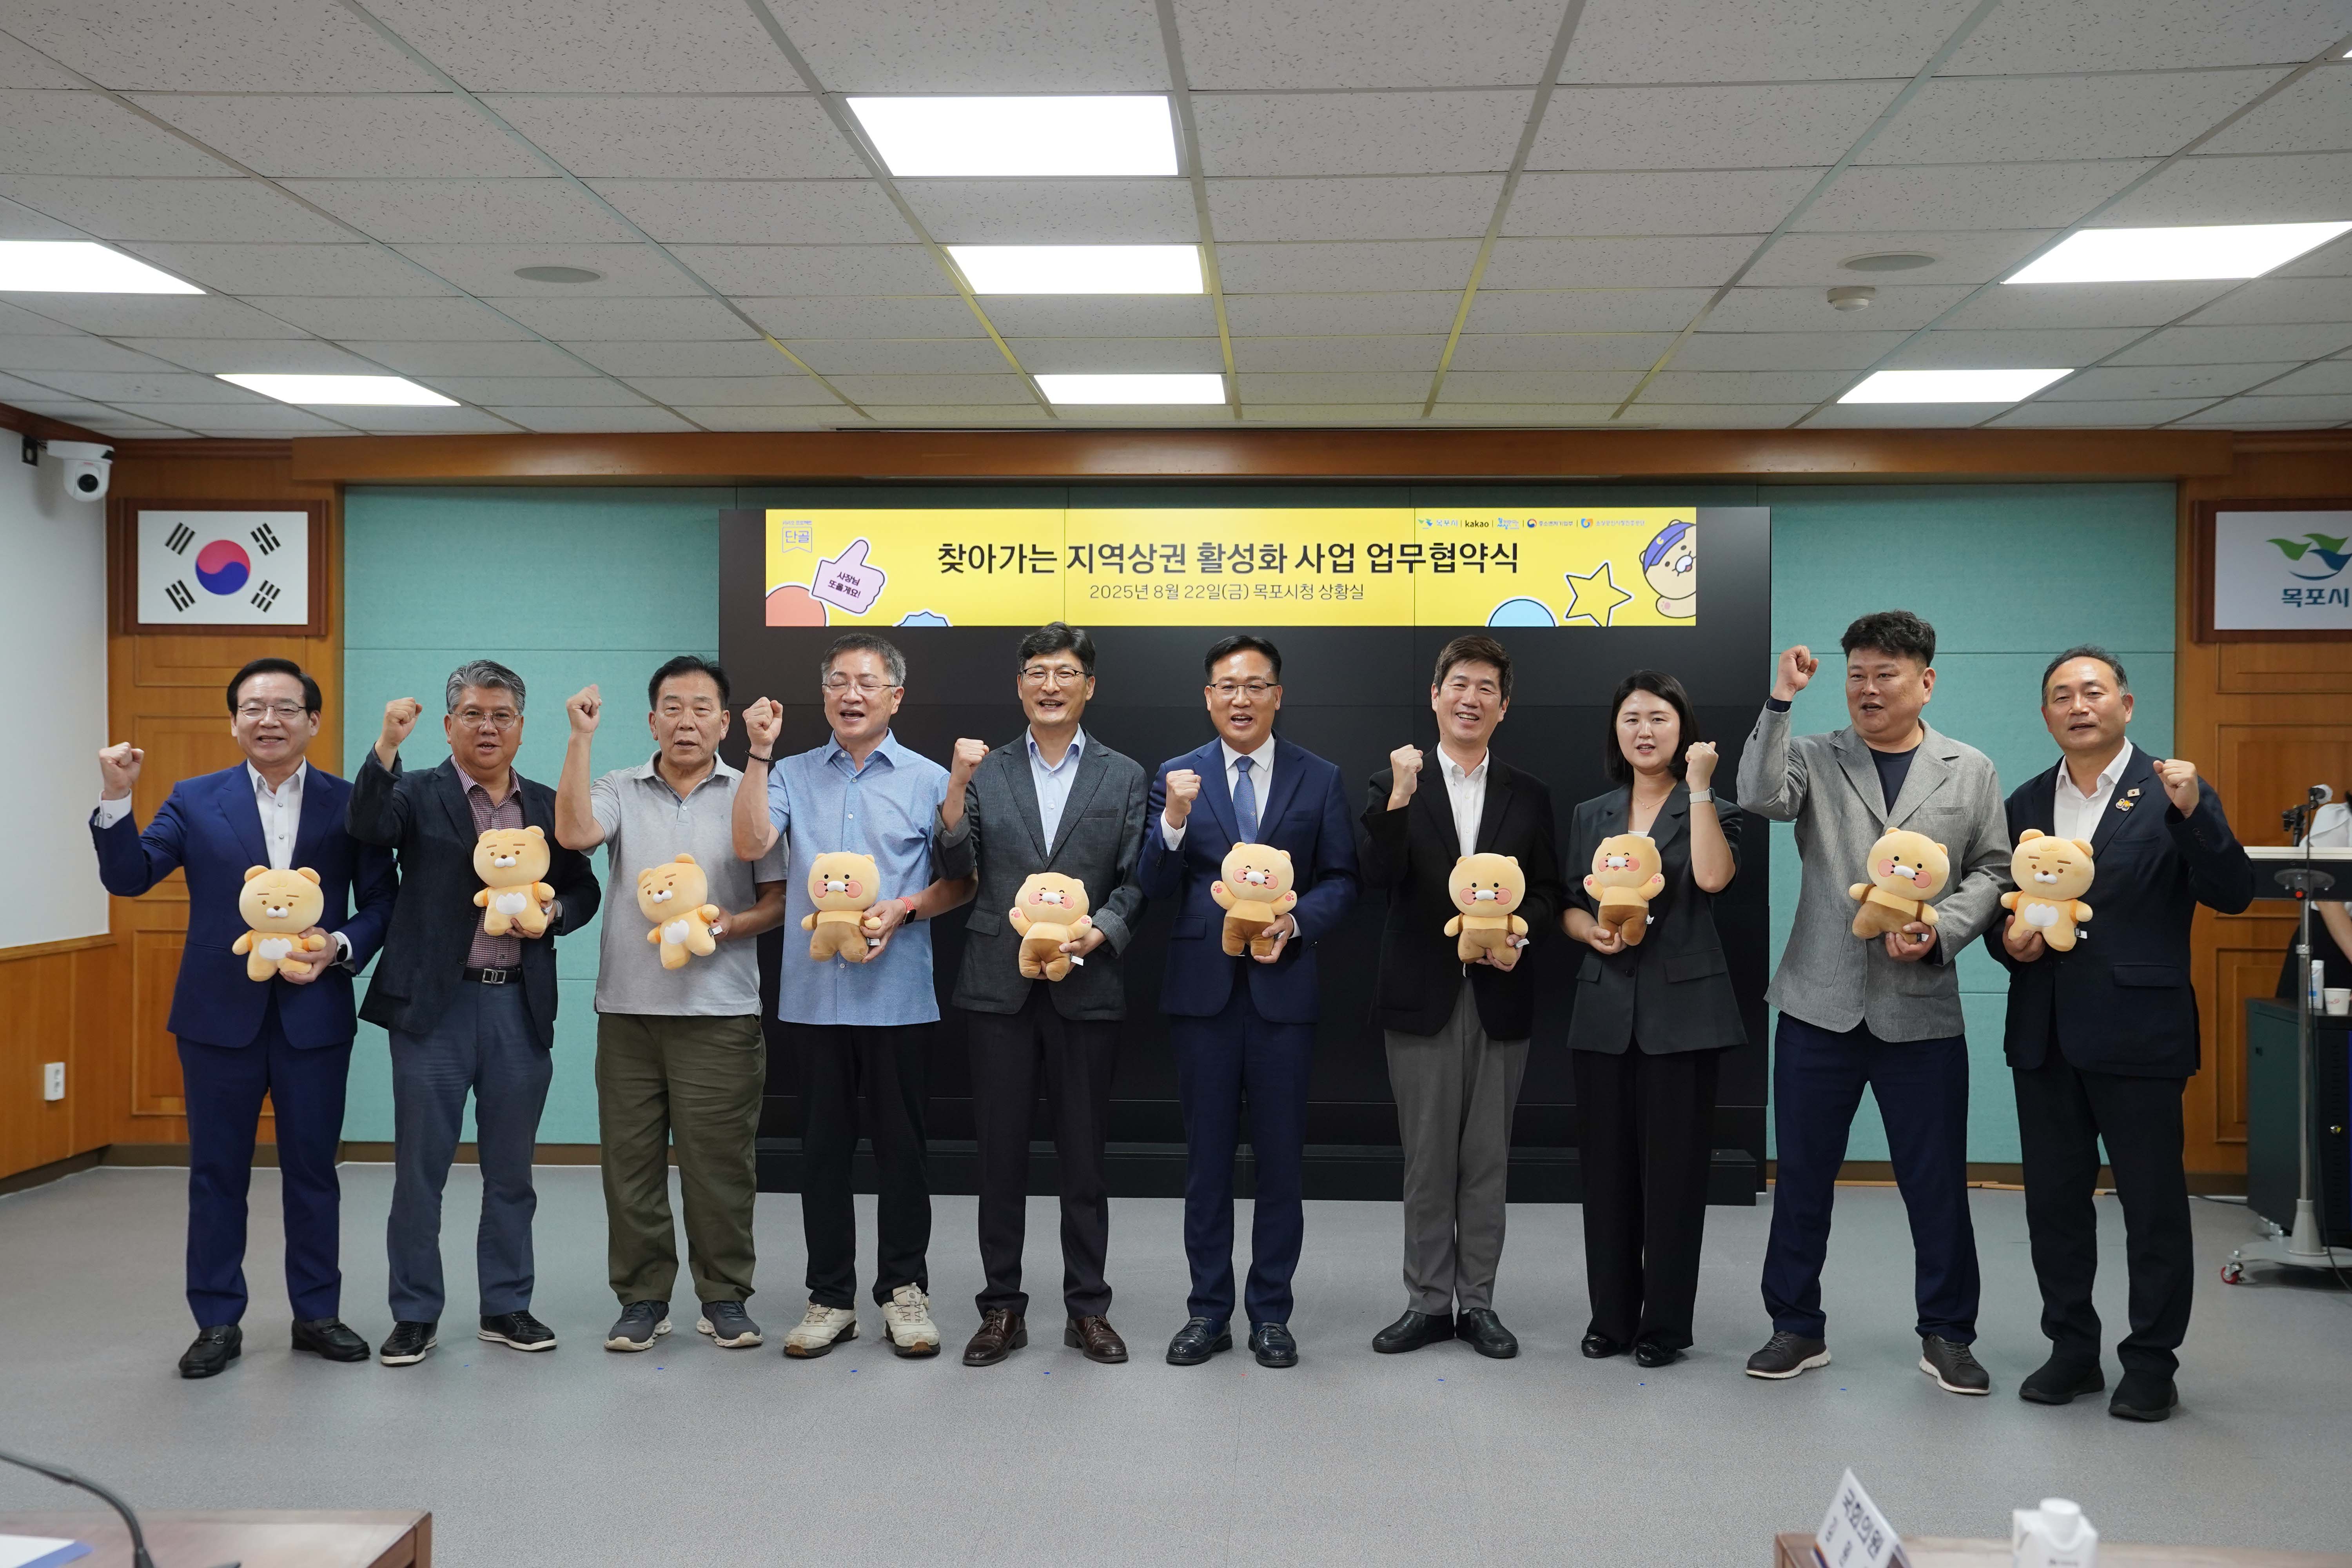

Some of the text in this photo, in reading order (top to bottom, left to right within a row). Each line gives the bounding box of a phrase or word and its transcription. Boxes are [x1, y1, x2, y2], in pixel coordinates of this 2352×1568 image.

[785, 530, 809, 543] 단골
[938, 543, 1518, 574] 찾아가는 지역상권 활성화 사업 업무협약식
[837, 571, 860, 586] 사장님
[1090, 584, 1364, 600] 2025년 8월 22일(금) 목포시청 상황실
[2281, 588, 2350, 608] 목포시
